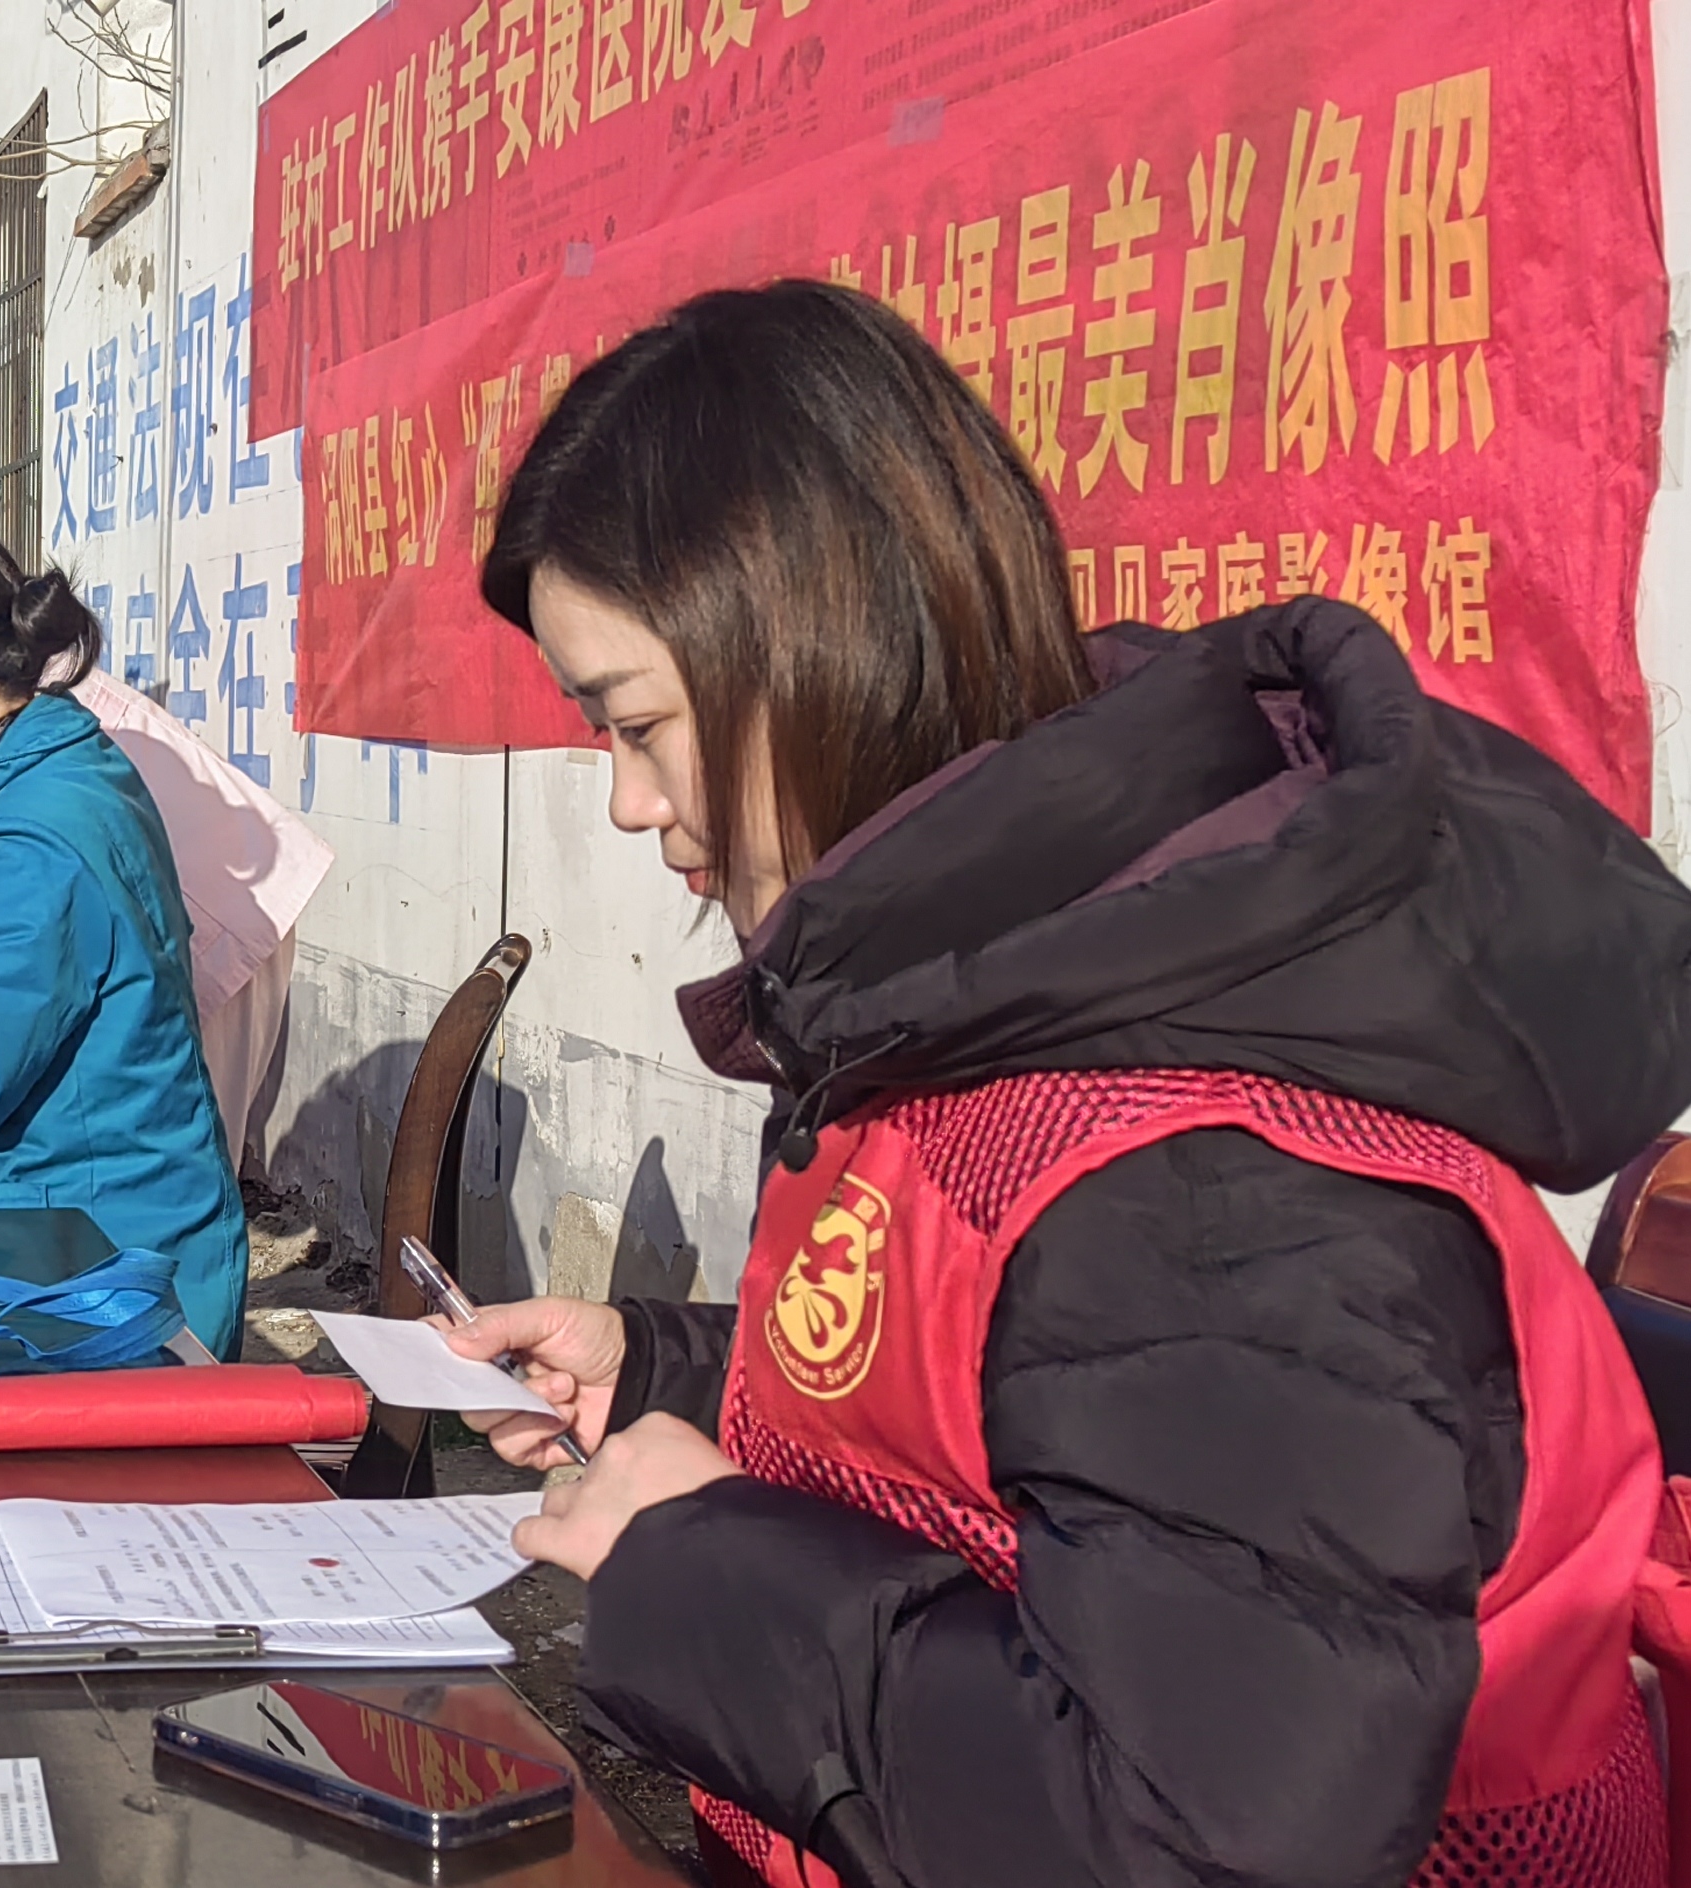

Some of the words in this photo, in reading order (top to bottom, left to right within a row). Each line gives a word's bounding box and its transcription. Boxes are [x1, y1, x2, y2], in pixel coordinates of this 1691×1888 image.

[52, 253, 303, 550] 交通法规在
